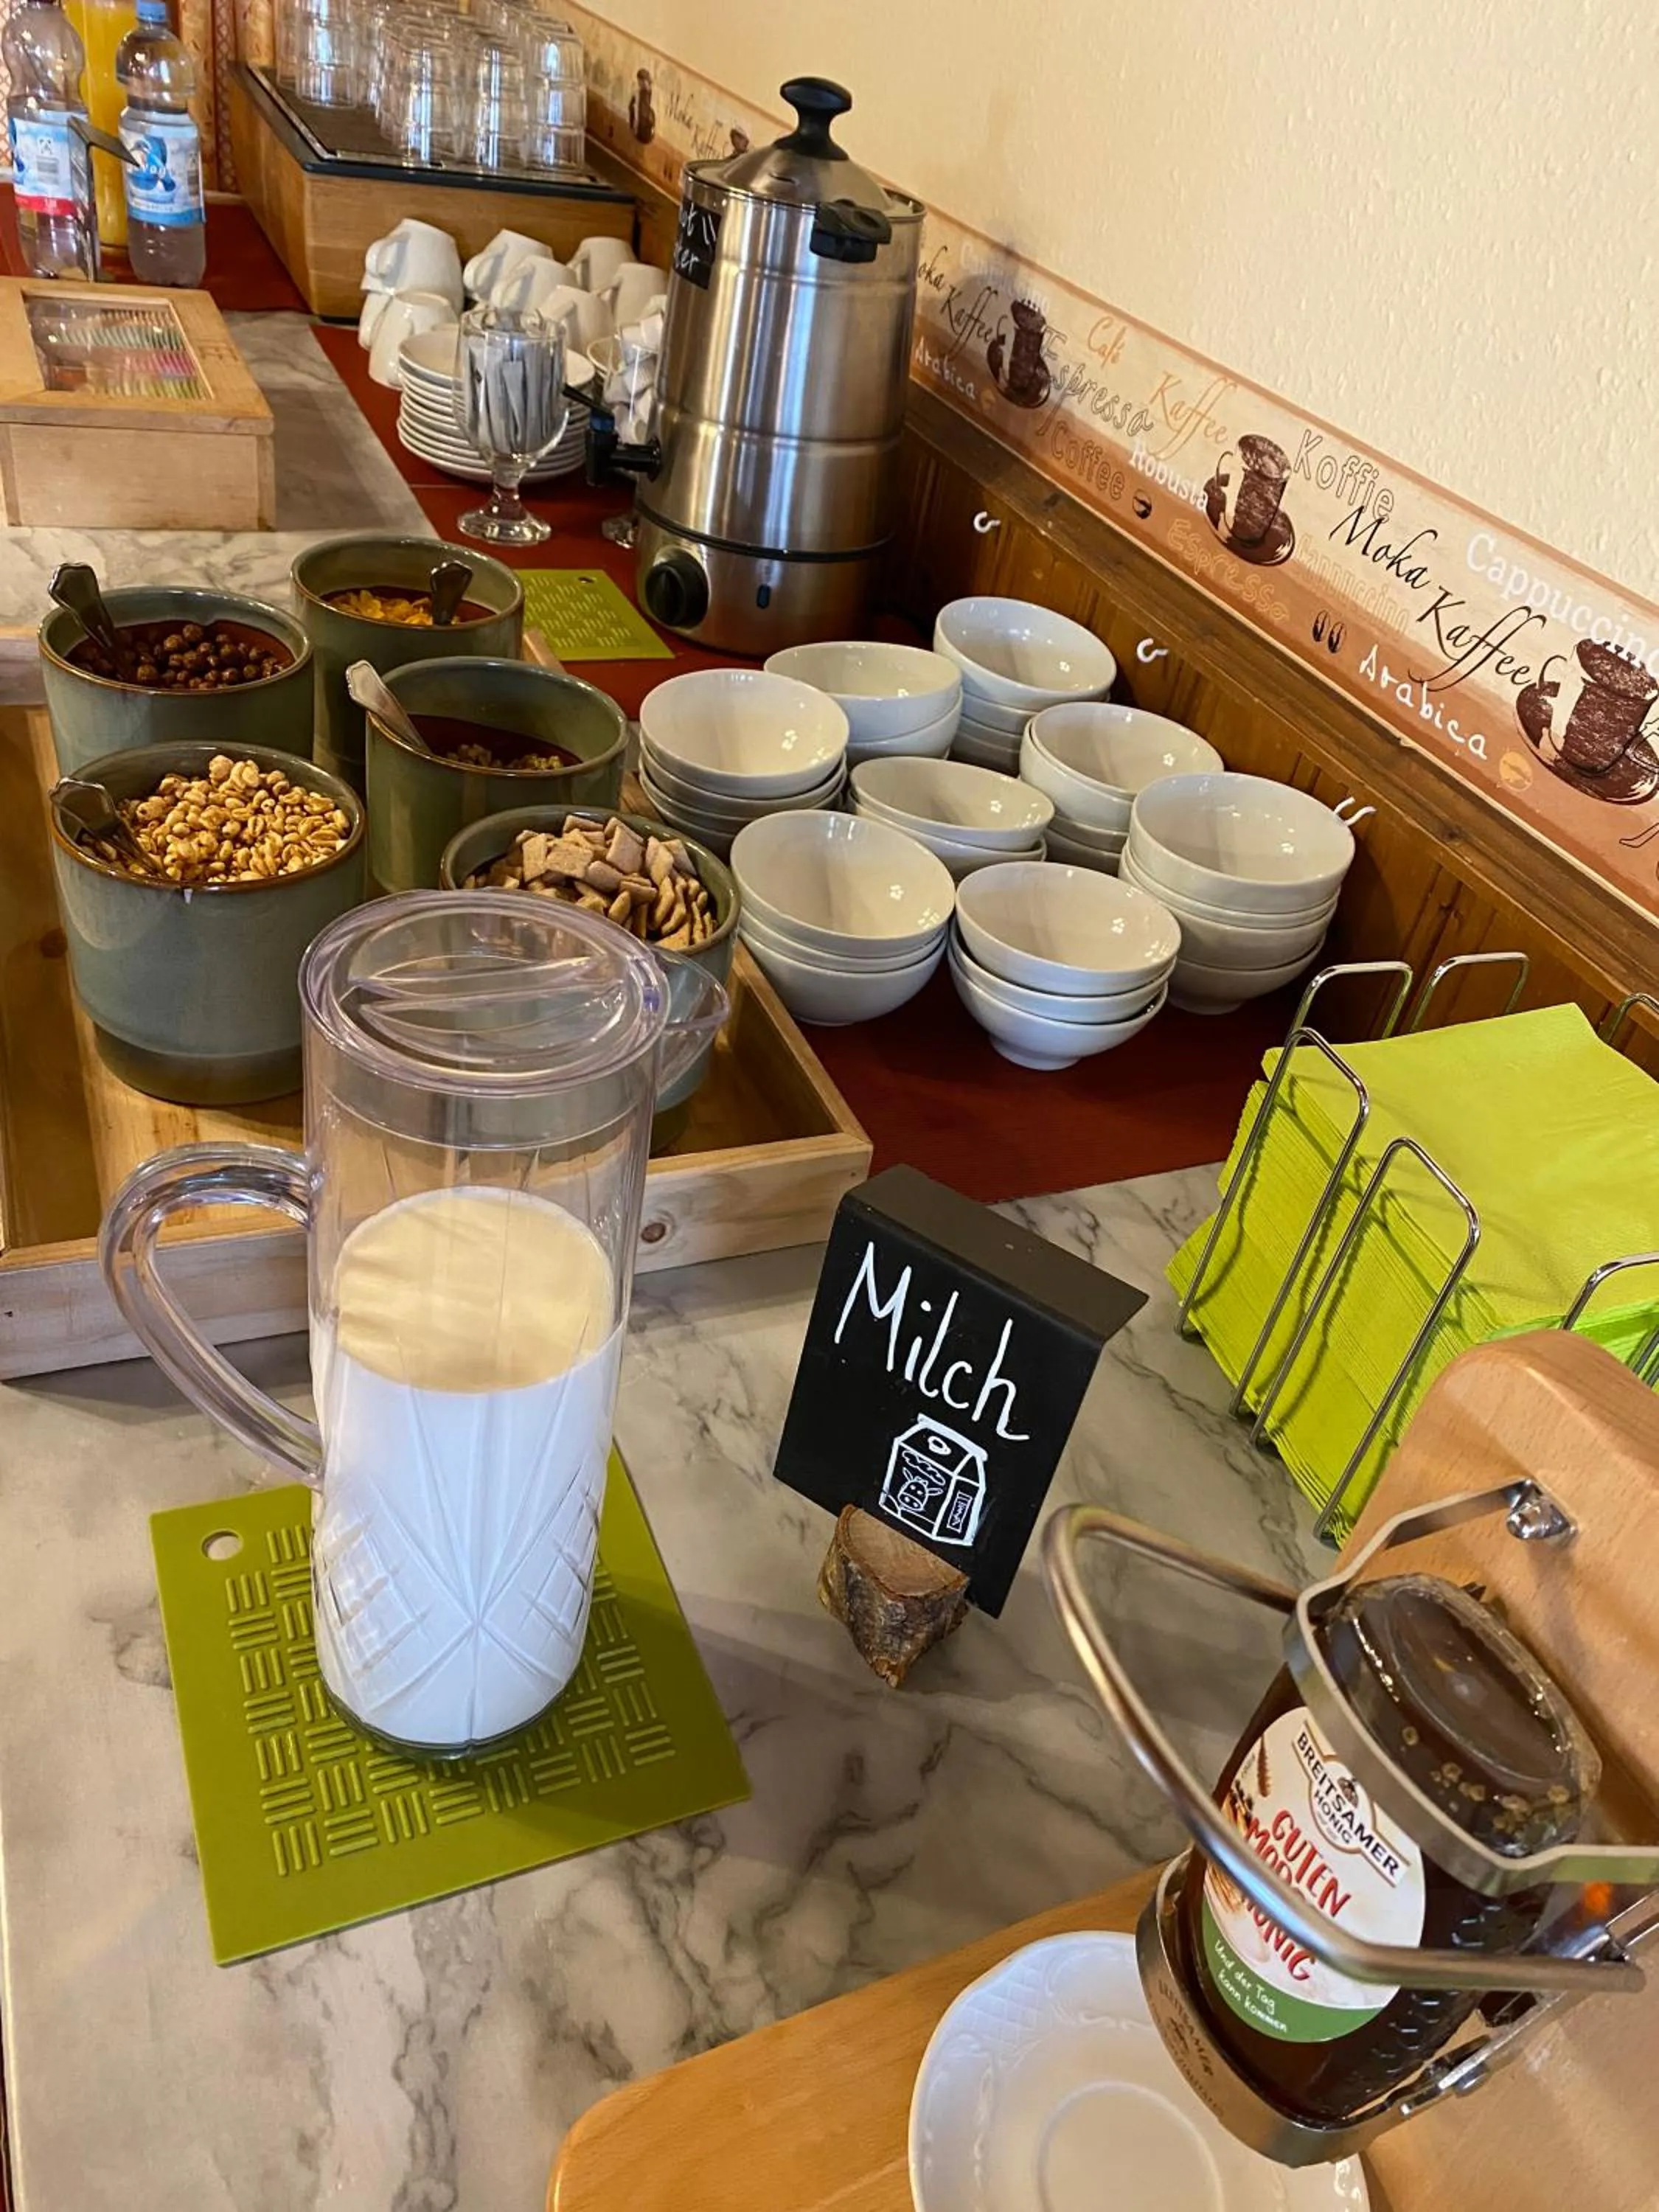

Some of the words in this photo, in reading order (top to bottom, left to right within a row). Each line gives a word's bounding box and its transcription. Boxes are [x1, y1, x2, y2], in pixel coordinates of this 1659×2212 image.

[918, 246, 947, 292] oka
[914, 335, 978, 399] Arabica
[939, 285, 998, 363] Kaffee
[1147, 371, 1239, 462] Kaffee
[1050, 419, 1127, 501] Coffee
[1129, 440, 1210, 513] Robusta
[1293, 428, 1396, 525] Koffie
[1167, 518, 1289, 621] Espresso
[1328, 505, 1438, 589] Moka
[1407, 585, 1547, 692] Kaffee
[1358, 644, 1488, 761] Arabica
[834, 1241, 1030, 1441] Milch
[1296, 1731, 1399, 1877] BREITSAMER
[1312, 1790, 1352, 1845] HONIG
[1271, 1809, 1352, 1917] GUTEN
[1215, 1940, 1234, 1969] Und
[1234, 1971, 1252, 1991] der
[1254, 1983, 1276, 2015] Tag
[1219, 1969, 1242, 2001] kann
[1244, 1995, 1287, 2033] kommen
